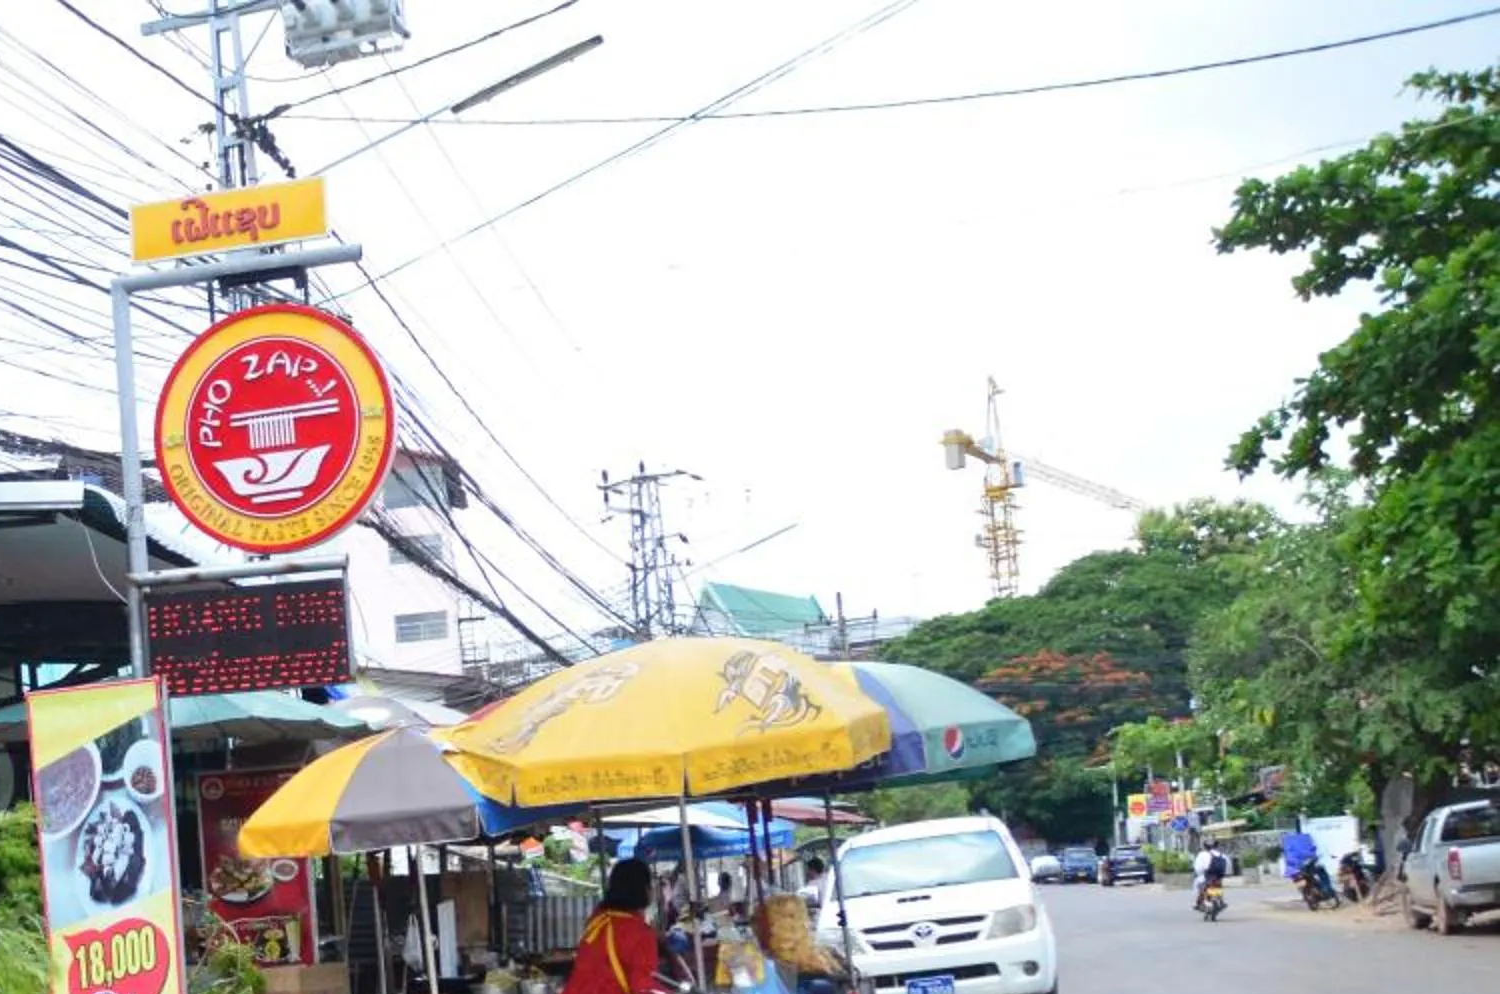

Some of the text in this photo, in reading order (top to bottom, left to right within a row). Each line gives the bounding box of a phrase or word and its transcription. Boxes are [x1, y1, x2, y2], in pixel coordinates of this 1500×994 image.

[198, 379, 233, 448] PHO
[169, 463, 246, 535] ORIGINAL
[249, 516, 311, 541] TASTE
[314, 475, 367, 528] SINCE
[75, 926, 155, 990] 18,000
